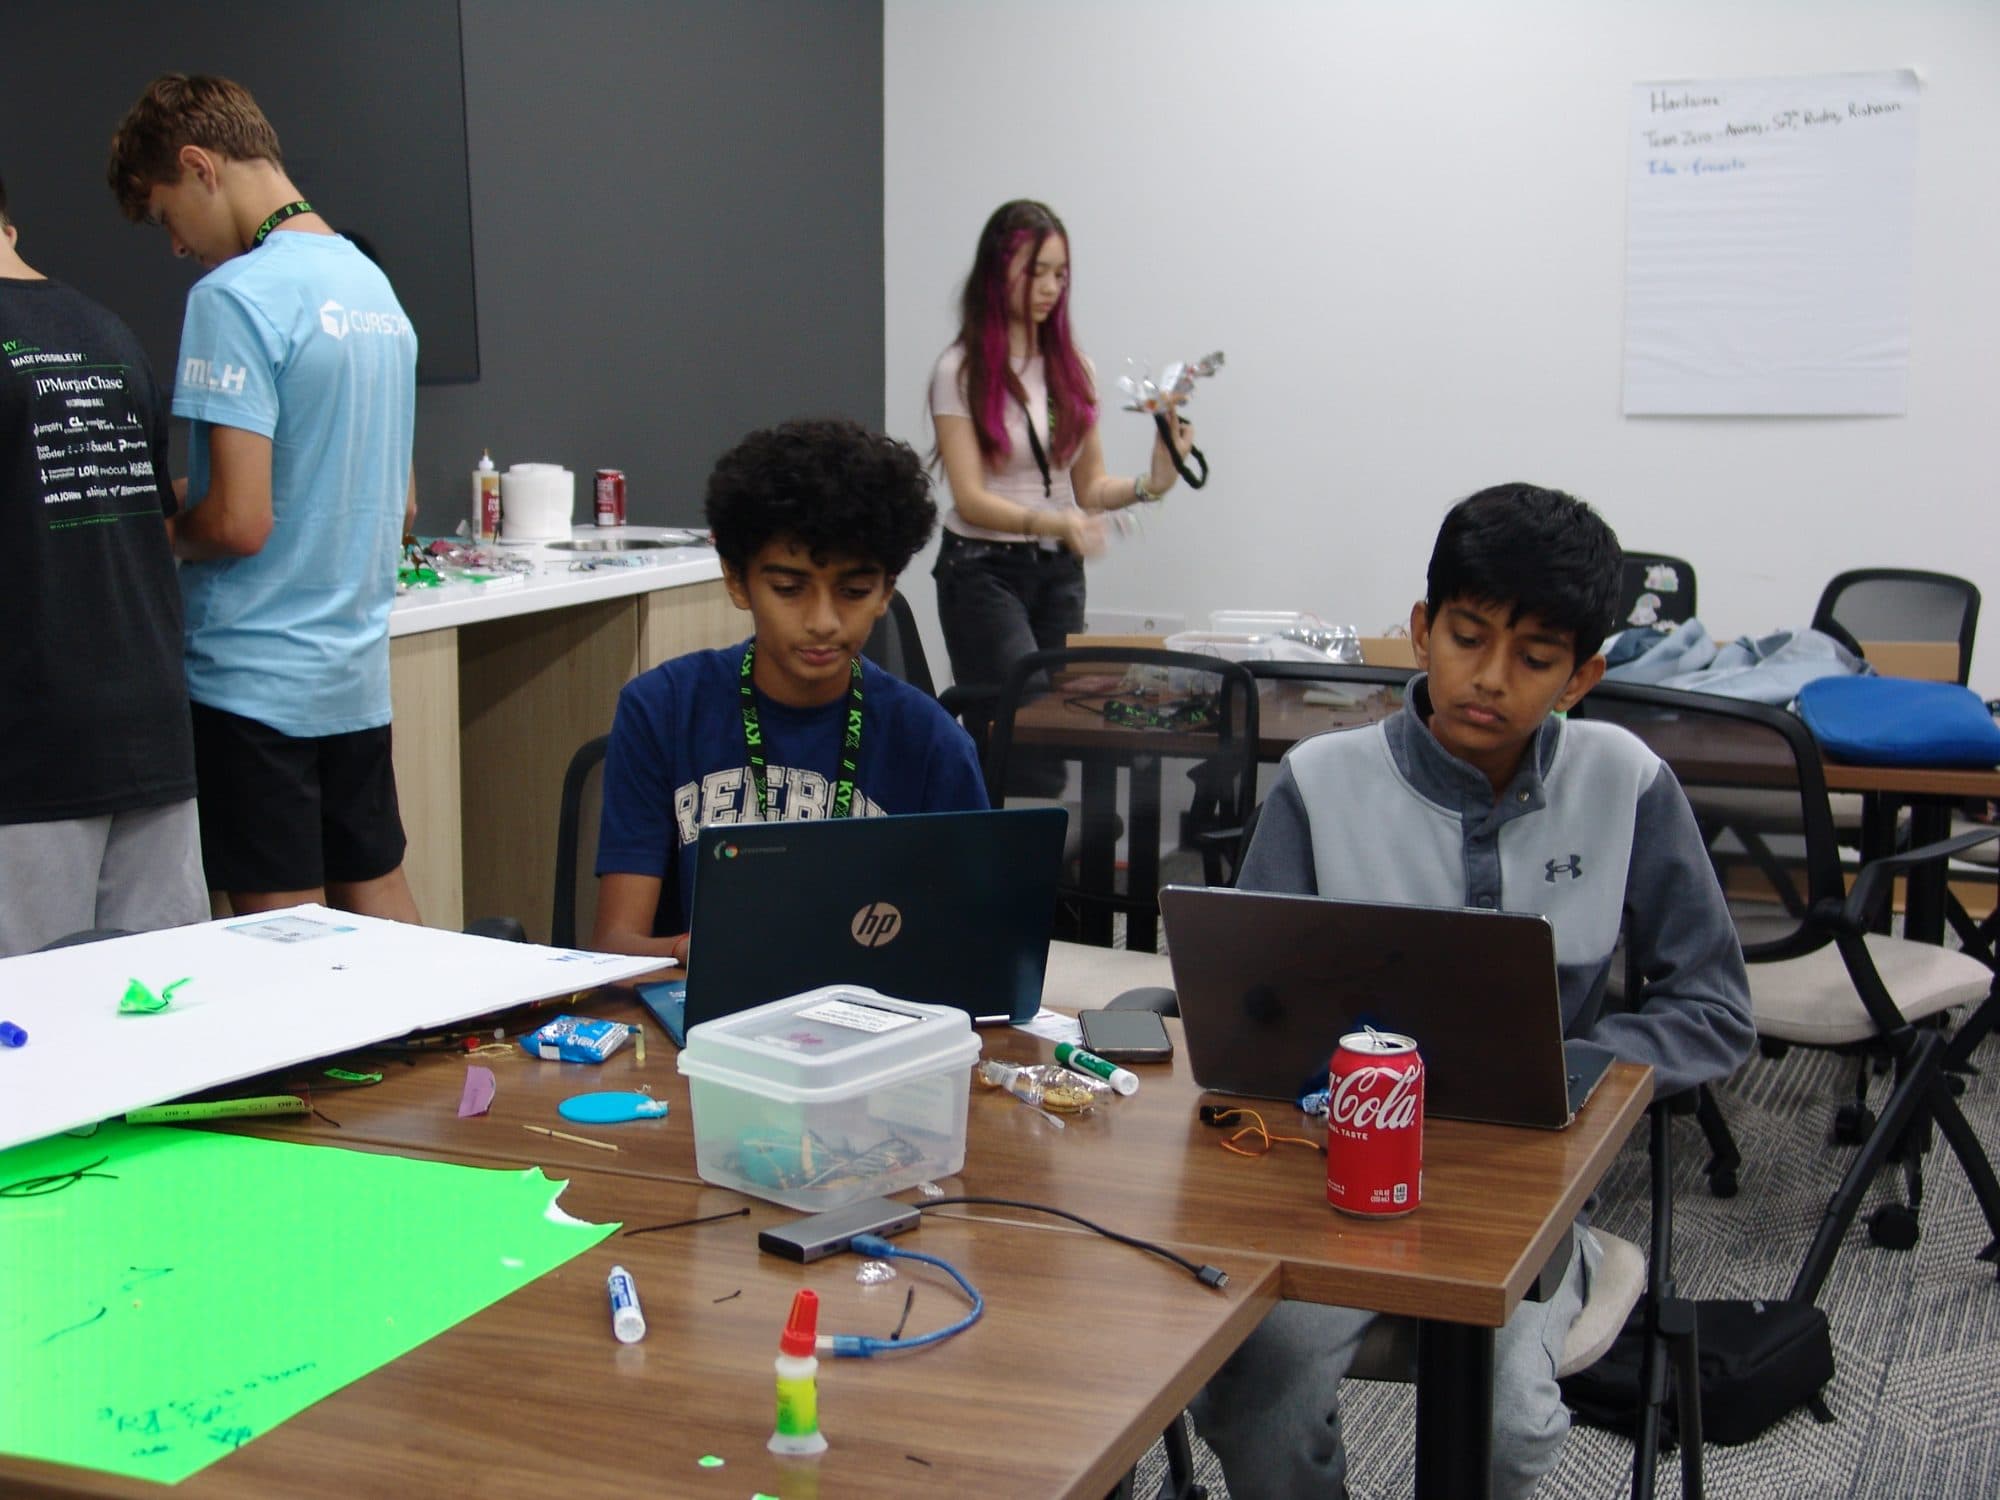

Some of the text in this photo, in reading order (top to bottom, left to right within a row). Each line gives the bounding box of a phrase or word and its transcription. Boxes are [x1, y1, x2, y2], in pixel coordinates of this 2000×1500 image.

[11, 355, 35, 369] MADE
[35, 352, 73, 364] POSSIBLE
[36, 375, 123, 396] JPMorganChase
[856, 901, 898, 947] hp
[1341, 1128, 1369, 1141] TASTE
